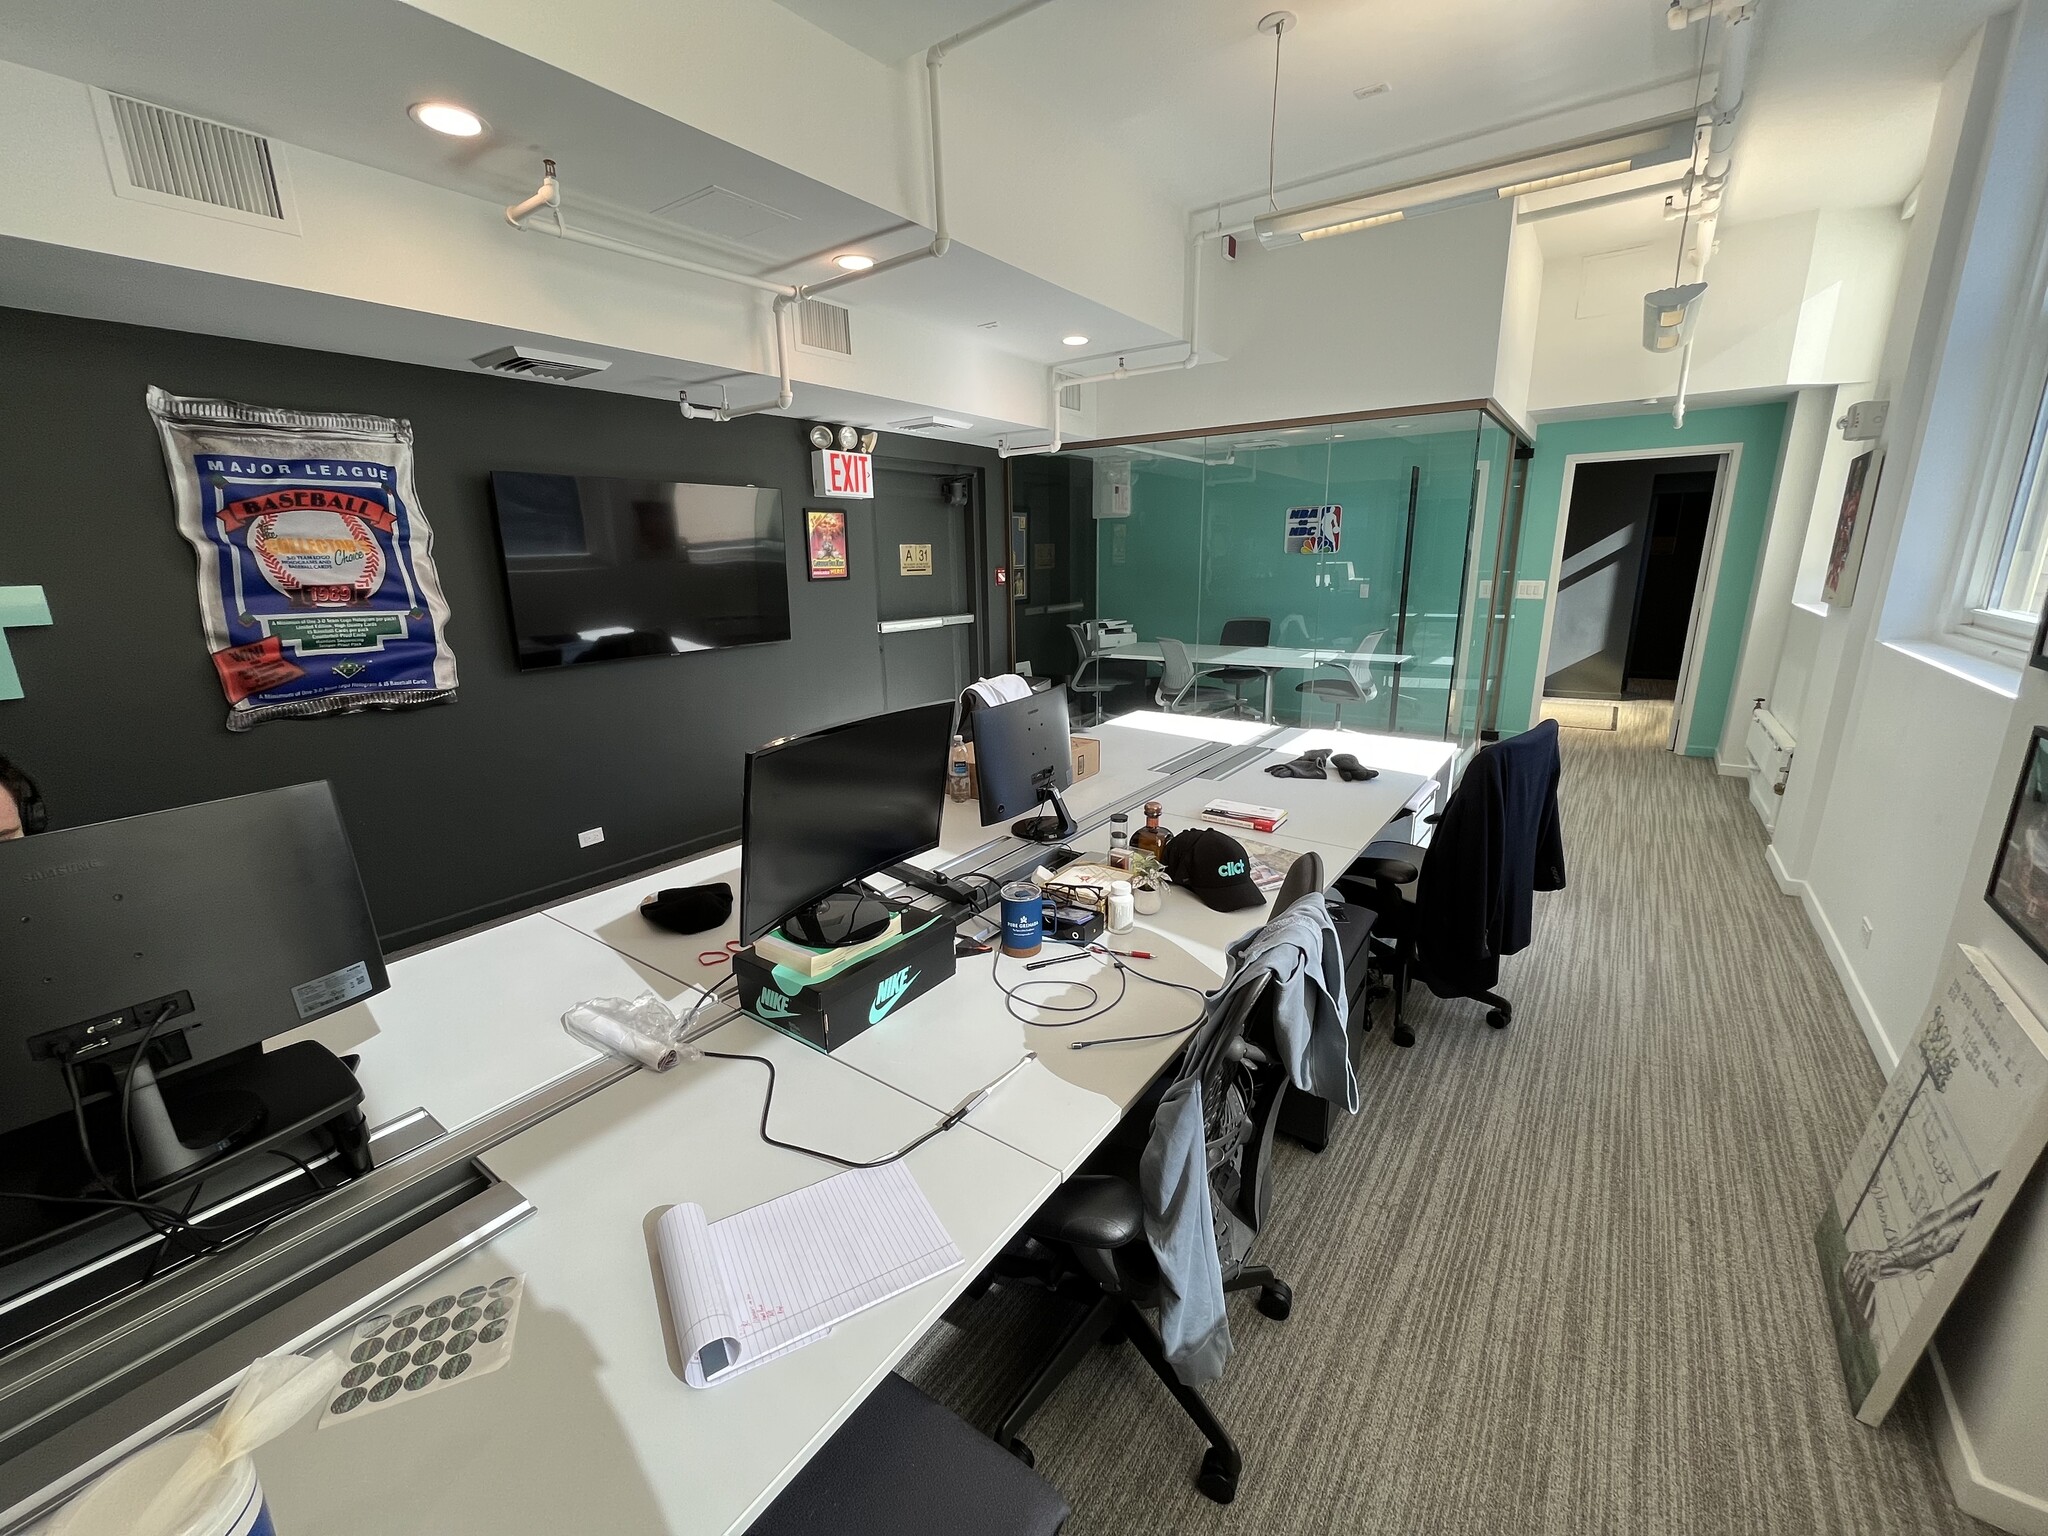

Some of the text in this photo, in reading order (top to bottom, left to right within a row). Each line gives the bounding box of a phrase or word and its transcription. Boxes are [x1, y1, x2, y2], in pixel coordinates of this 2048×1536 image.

[207, 460, 389, 481] MAJOR LEAGUE
[829, 453, 868, 493] EXIT
[242, 491, 372, 517] BASEBALL
[1289, 508, 1319, 520] NBA
[1288, 526, 1317, 537] NBC
[334, 548, 364, 566] Choice
[905, 549, 928, 562] A 31
[311, 585, 352, 602] 1989
[876, 966, 911, 1006] NIKE
[760, 986, 790, 1012] NIKE
